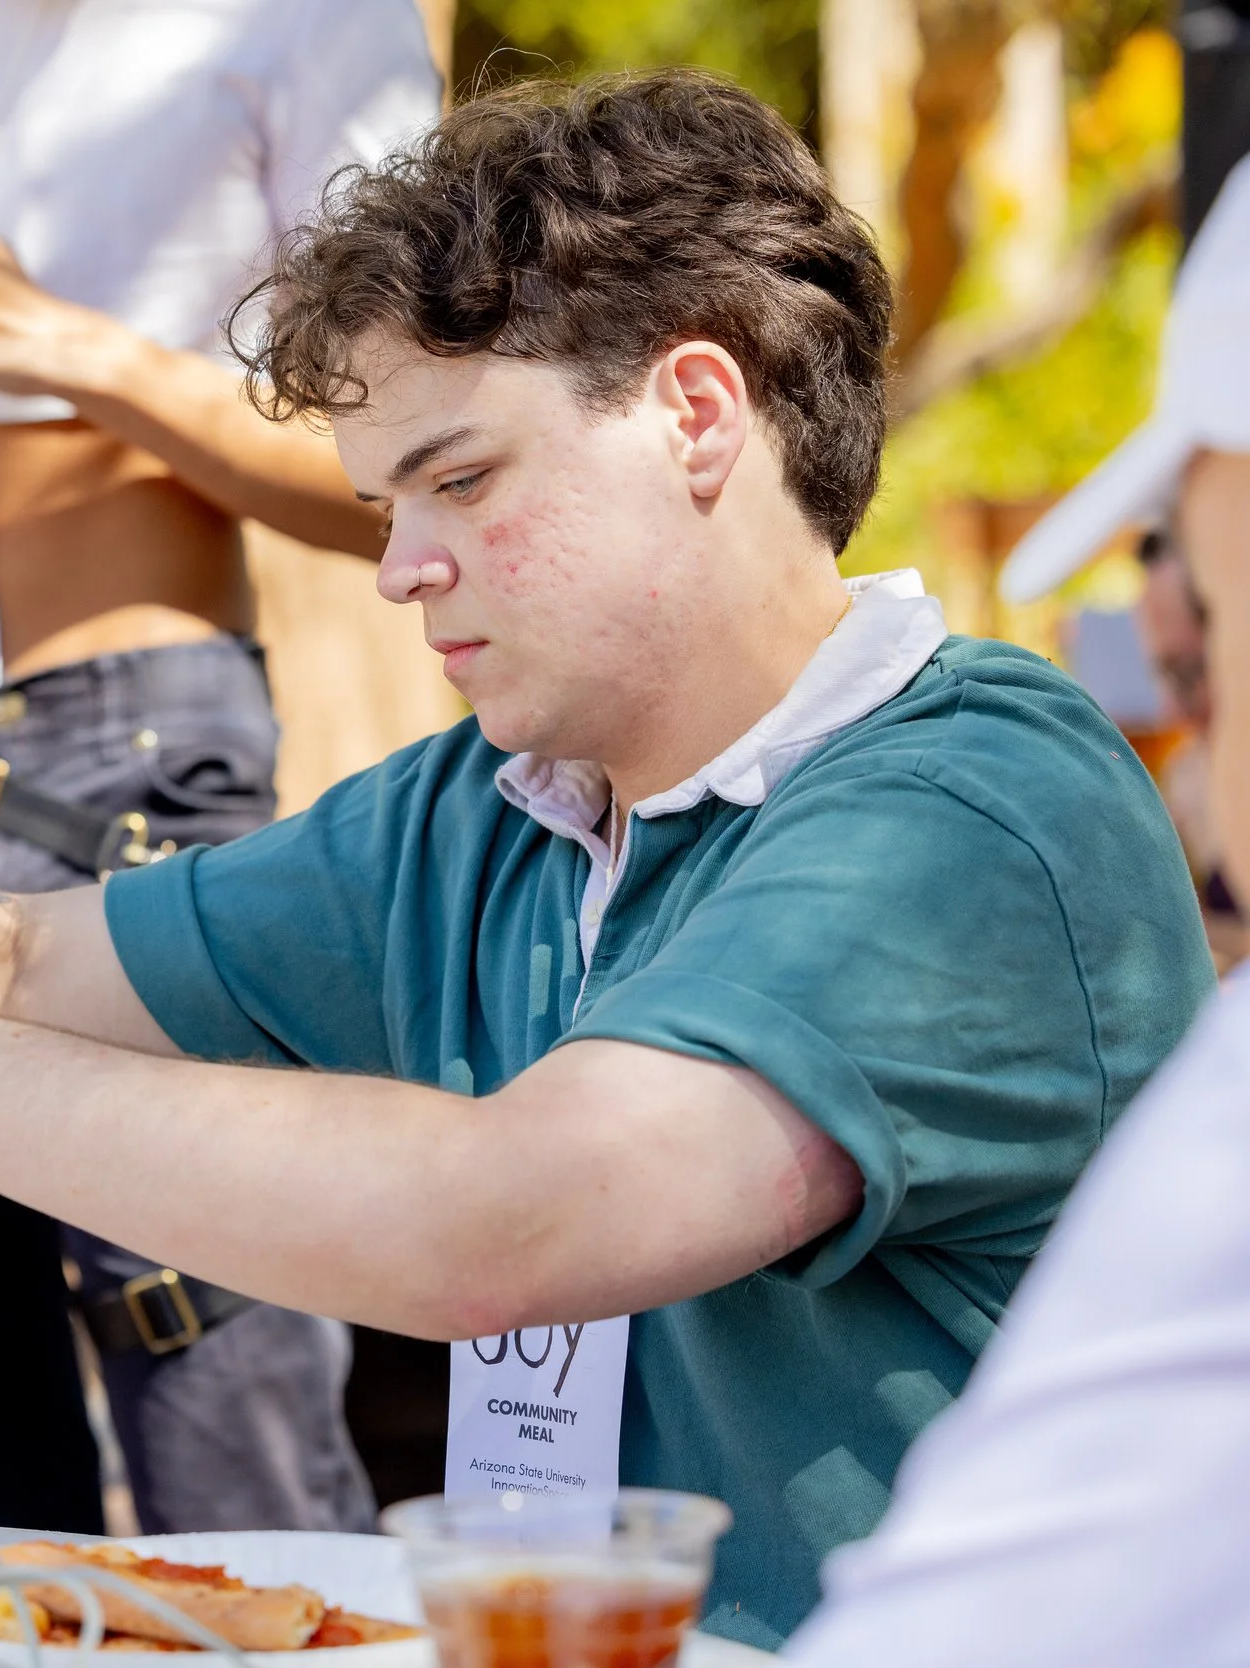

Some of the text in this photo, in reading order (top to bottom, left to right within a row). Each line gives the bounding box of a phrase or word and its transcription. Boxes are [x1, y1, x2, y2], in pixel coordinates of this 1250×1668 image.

[487, 1398, 578, 1425] COMMUNITY
[518, 1423, 555, 1443] MEAL
[469, 1458, 587, 1491] Arizona State University
